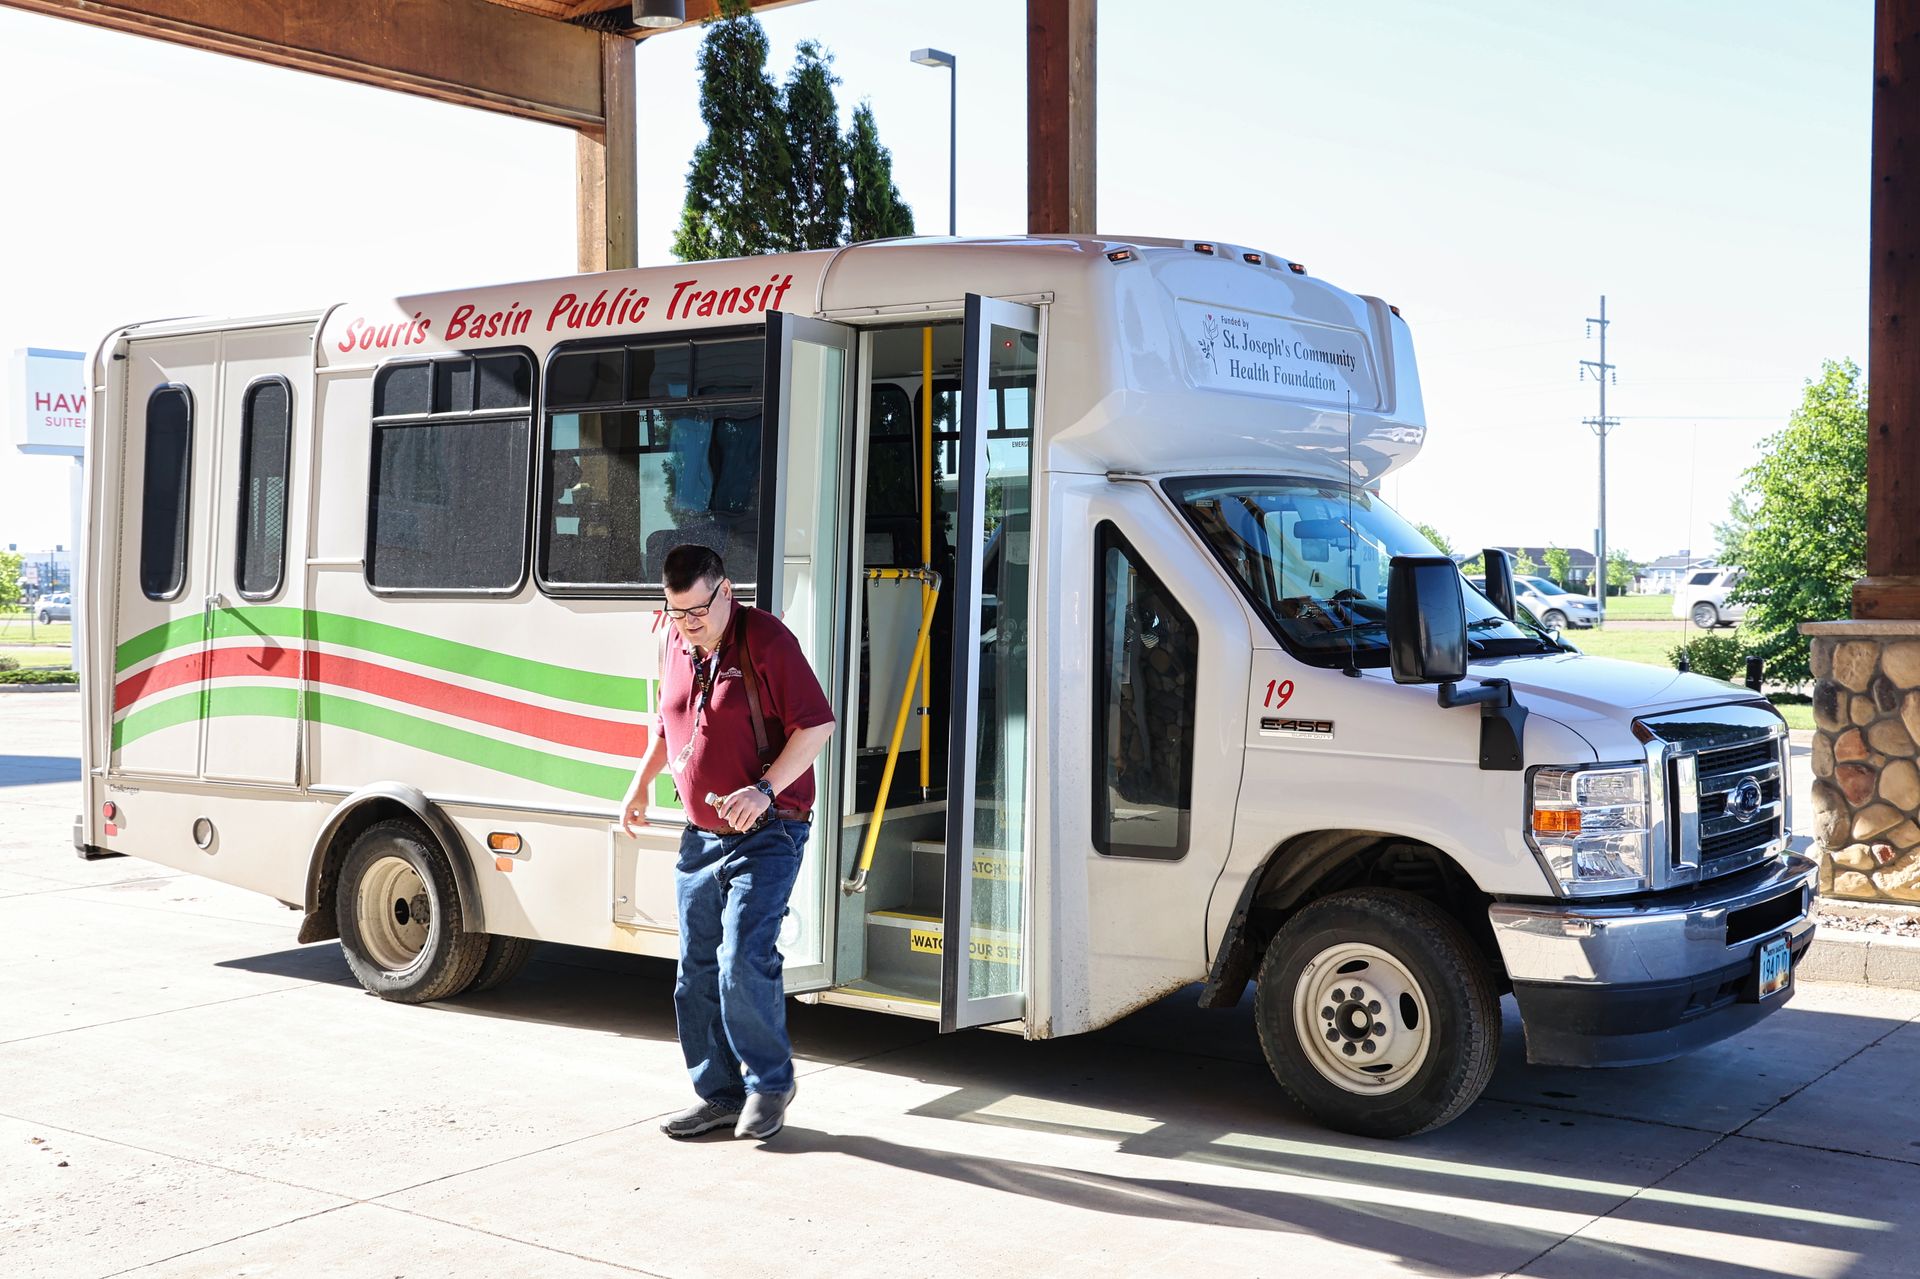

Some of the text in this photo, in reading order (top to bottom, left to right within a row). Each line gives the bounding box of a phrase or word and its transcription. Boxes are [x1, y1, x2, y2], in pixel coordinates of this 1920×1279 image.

[338, 274, 793, 353] Souris Basin Public Transit
[1221, 315, 1249, 330] Funded by
[1223, 330, 1356, 372] St. Joseph's Community
[1229, 358, 1336, 392] Health Foundation
[1264, 680, 1294, 709] 19
[1261, 719, 1332, 733] E-450
[972, 861, 1001, 875] ATCH
[969, 942, 993, 956] OUR
